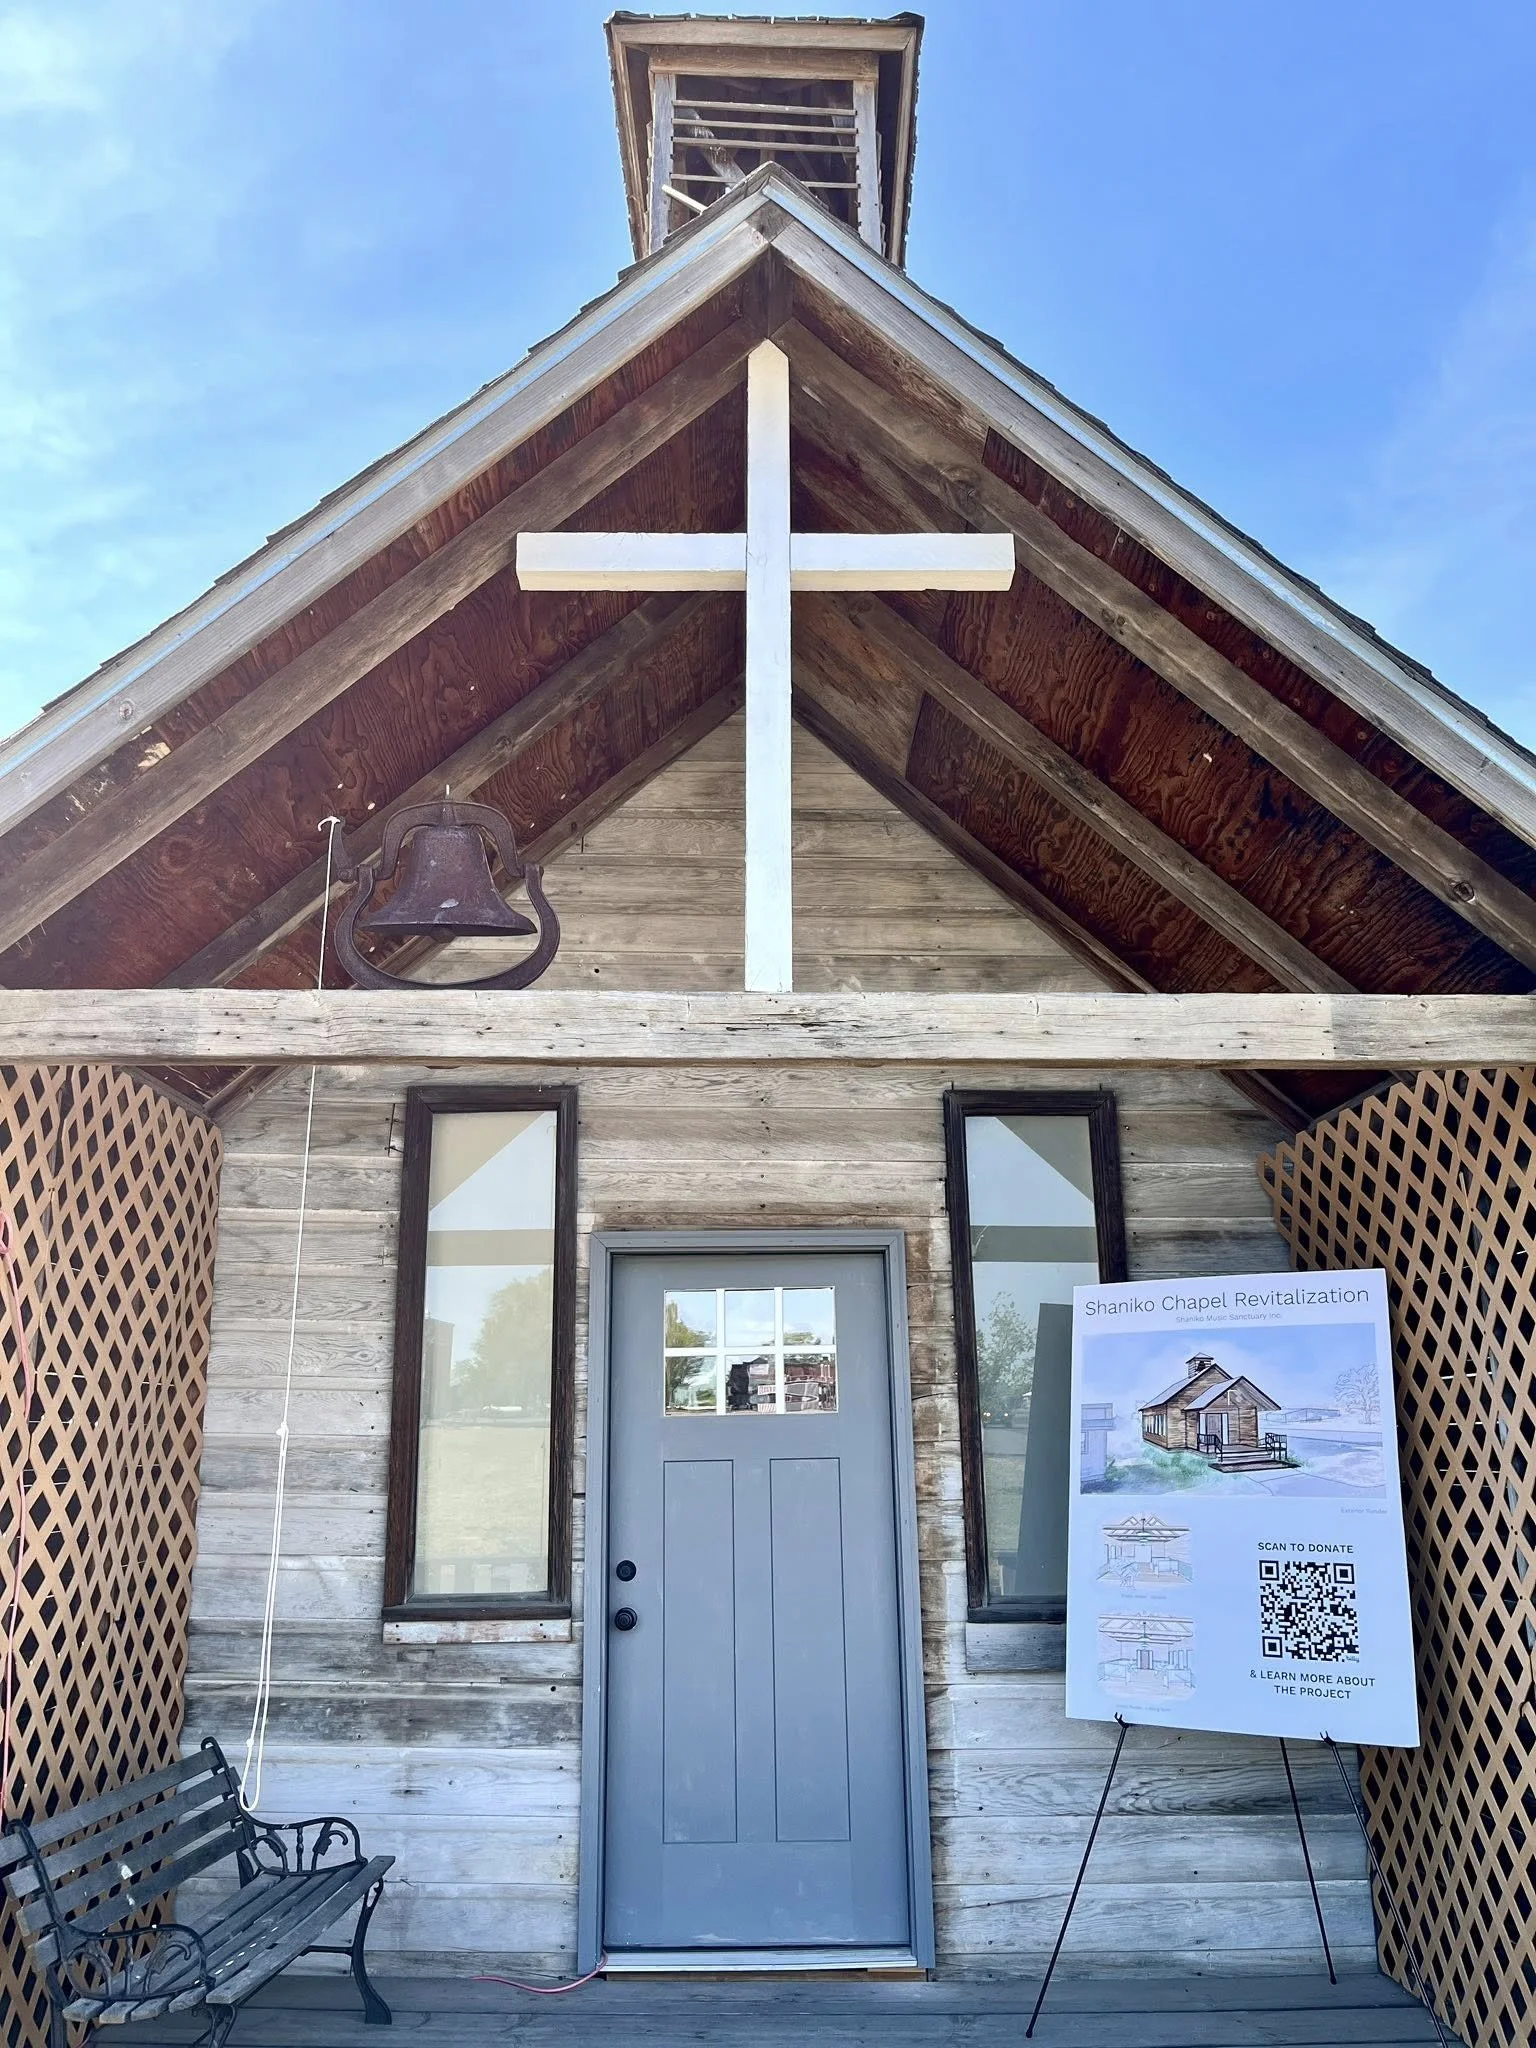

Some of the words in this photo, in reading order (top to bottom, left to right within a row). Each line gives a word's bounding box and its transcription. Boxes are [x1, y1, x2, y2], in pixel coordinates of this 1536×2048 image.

[1085, 1297, 1155, 1316] Shaniko
[1161, 1291, 1227, 1312] Chapel
[1235, 1287, 1369, 1308] Revitalization
[1176, 1314, 1204, 1323] Shaniko
[1206, 1313, 1227, 1322] Music
[1229, 1312, 1267, 1321] Sanctuary
[1258, 1542, 1287, 1551] SCAN
[1290, 1543, 1305, 1552] TO
[1308, 1543, 1354, 1554] DONATE
[1250, 1670, 1257, 1679] &
[1260, 1670, 1296, 1681] LEARN
[1300, 1673, 1333, 1684] MORE
[1337, 1676, 1376, 1687] ABOUT
[1274, 1685, 1296, 1695] THE
[1299, 1687, 1352, 1700] PROJECT
